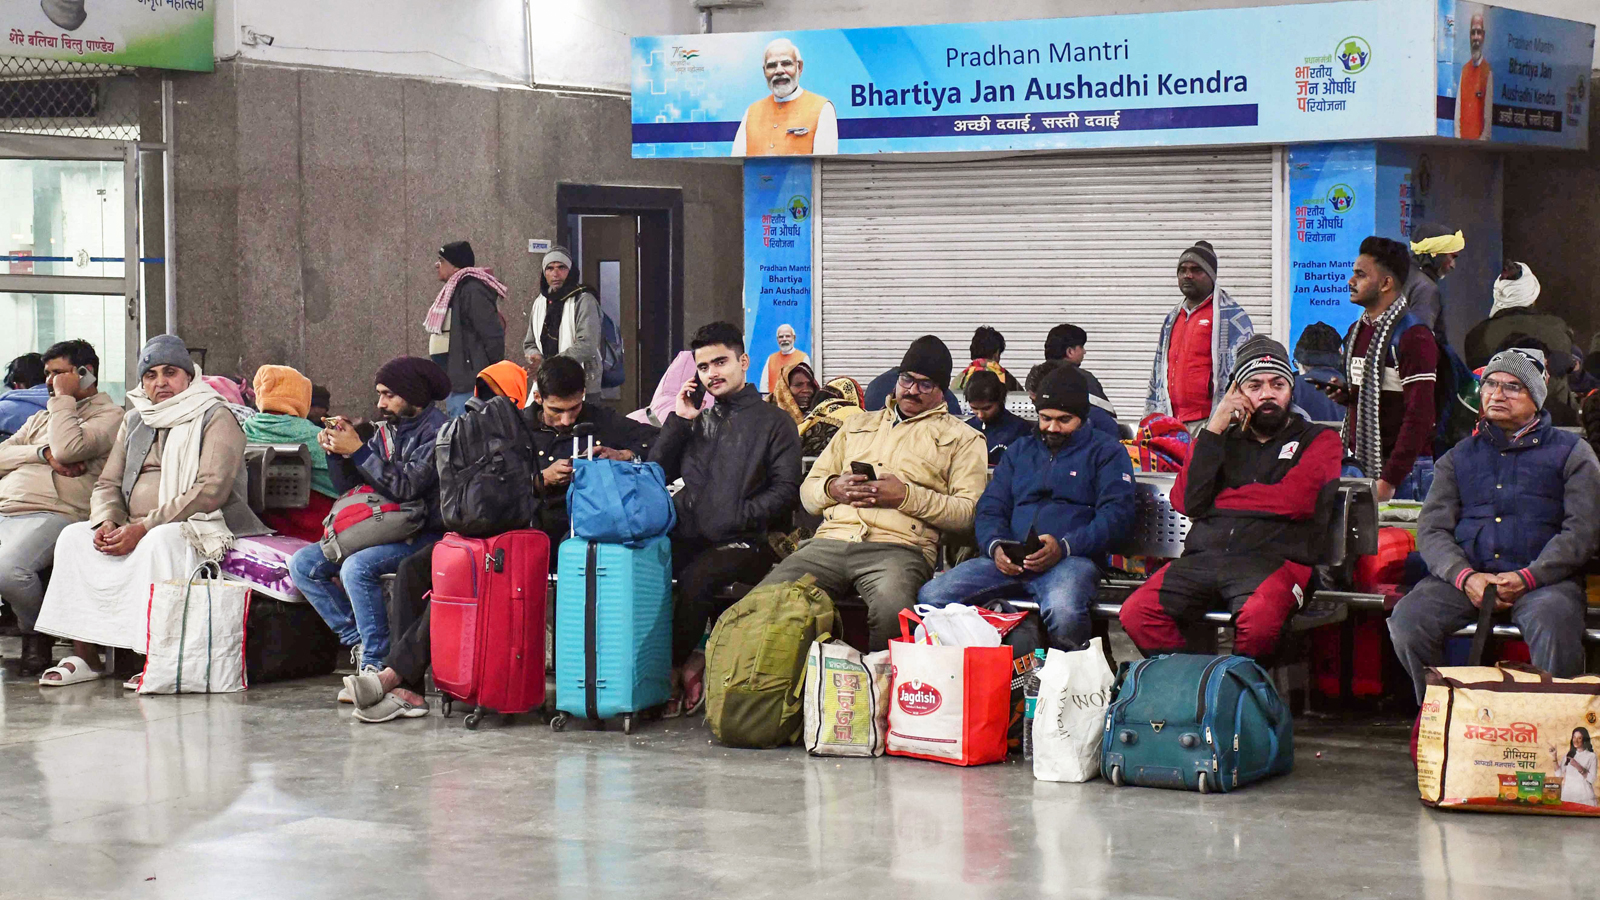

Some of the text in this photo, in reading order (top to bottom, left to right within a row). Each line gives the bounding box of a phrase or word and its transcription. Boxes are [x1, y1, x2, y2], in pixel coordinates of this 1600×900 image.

[9, 28, 25, 46] शेरे
[28, 31, 58, 48] बलिया
[86, 37, 114, 52] पाण्डेय
[946, 39, 1129, 68] Pradhan Mantri
[1295, 64, 1332, 79] भारतीय
[851, 70, 1248, 111] Bhartiya Jan Aushadhi Kendra
[1295, 77, 1356, 96] जन औषधि
[1297, 97, 1346, 112] परियोजना
[954, 110, 1121, 132] अच्छी दवाई, सस्ती दवाई
[1295, 205, 1325, 217] भारतीय
[1296, 216, 1344, 230] जन औषधि
[762, 225, 777, 236] जन
[1297, 230, 1336, 243] परियोजना
[789, 264, 811, 272] Mantri
[769, 275, 802, 285] Bhartiya
[1304, 272, 1346, 283] Bhartiya
[776, 286, 811, 295] Aushadhi
[1294, 285, 1351, 293] Jan Aushad
[1310, 298, 1340, 306] Kendra
[900, 690, 935, 705] Jagdish
[1464, 722, 1538, 743] महारानी
[1503, 748, 1537, 760] प्रीमियम
[1517, 761, 1536, 769] चाय
